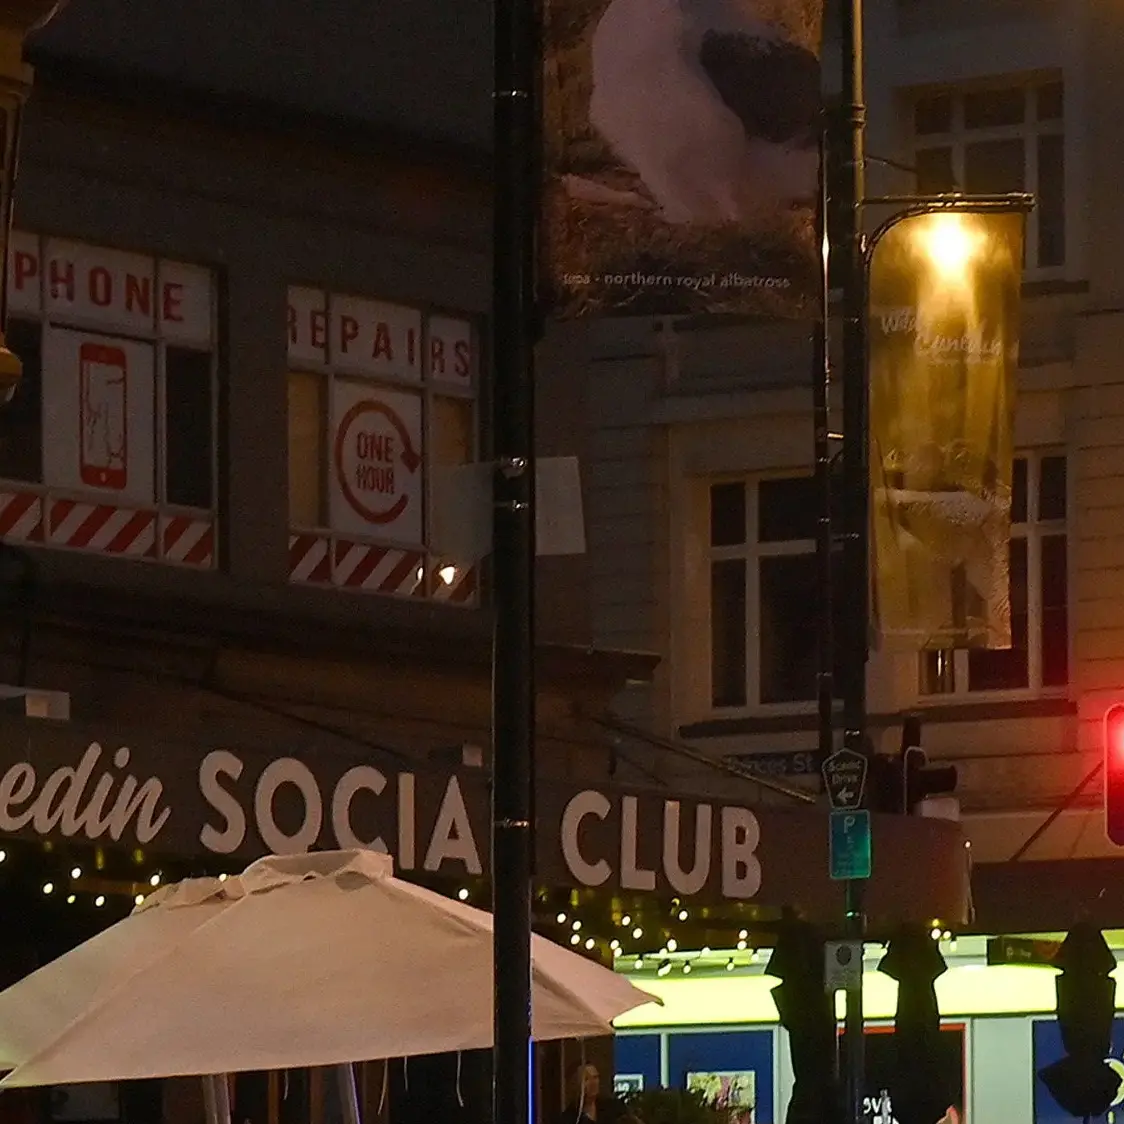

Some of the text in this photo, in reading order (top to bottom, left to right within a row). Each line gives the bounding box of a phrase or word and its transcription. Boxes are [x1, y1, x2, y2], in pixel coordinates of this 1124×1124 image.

[14, 251, 184, 322] PHONE
[604, 271, 673, 287] northern
[676, 273, 716, 290] royal
[719, 272, 791, 288] albatross
[287, 305, 469, 378] REPAIRS
[357, 432, 395, 463] ONE
[356, 463, 395, 495] HOUR
[200, 749, 483, 875] SOCIA
[560, 789, 763, 899] CLUB
